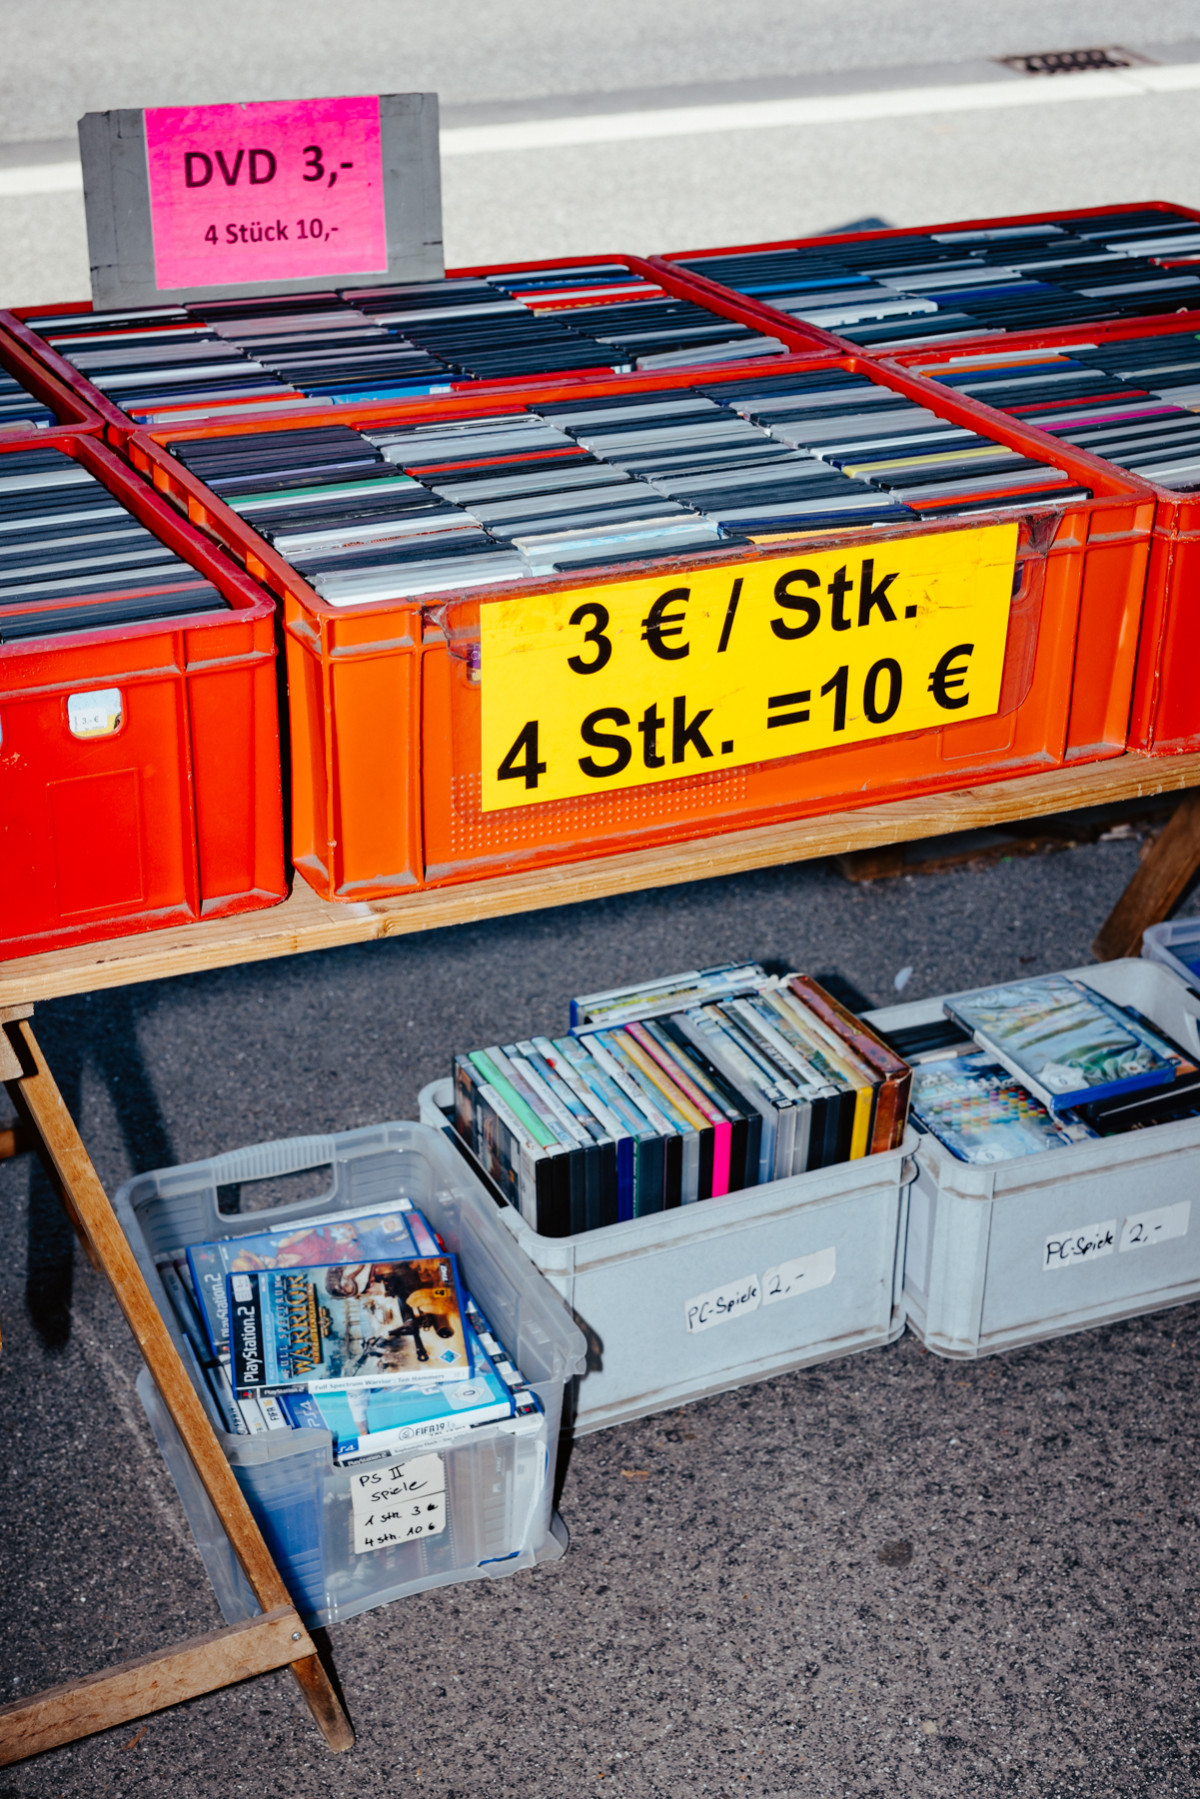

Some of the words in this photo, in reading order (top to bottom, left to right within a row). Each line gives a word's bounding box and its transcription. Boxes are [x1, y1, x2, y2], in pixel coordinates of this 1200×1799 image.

[184, 148, 277, 188] DVD
[302, 145, 354, 188] 3,-
[204, 224, 219, 245] 4
[225, 219, 289, 244] Stück
[296, 218, 339, 242] 10,-
[567, 602, 612, 675] 3
[640, 587, 691, 660] €
[717, 578, 744, 653] /
[769, 558, 918, 640] Stk.
[497, 720, 547, 789] 4
[578, 695, 734, 778] Stk.
[927, 643, 974, 710] €
[285, 1273, 313, 1375] WARRIOR
[300, 1400, 321, 1428] PS4
[359, 1473, 382, 1487] PS
[388, 1463, 405, 1480] II
[364, 1515, 374, 1526] 1
[411, 1506, 421, 1515] 3
[364, 1538, 374, 1546] 4
[406, 1526, 423, 1536] 10
